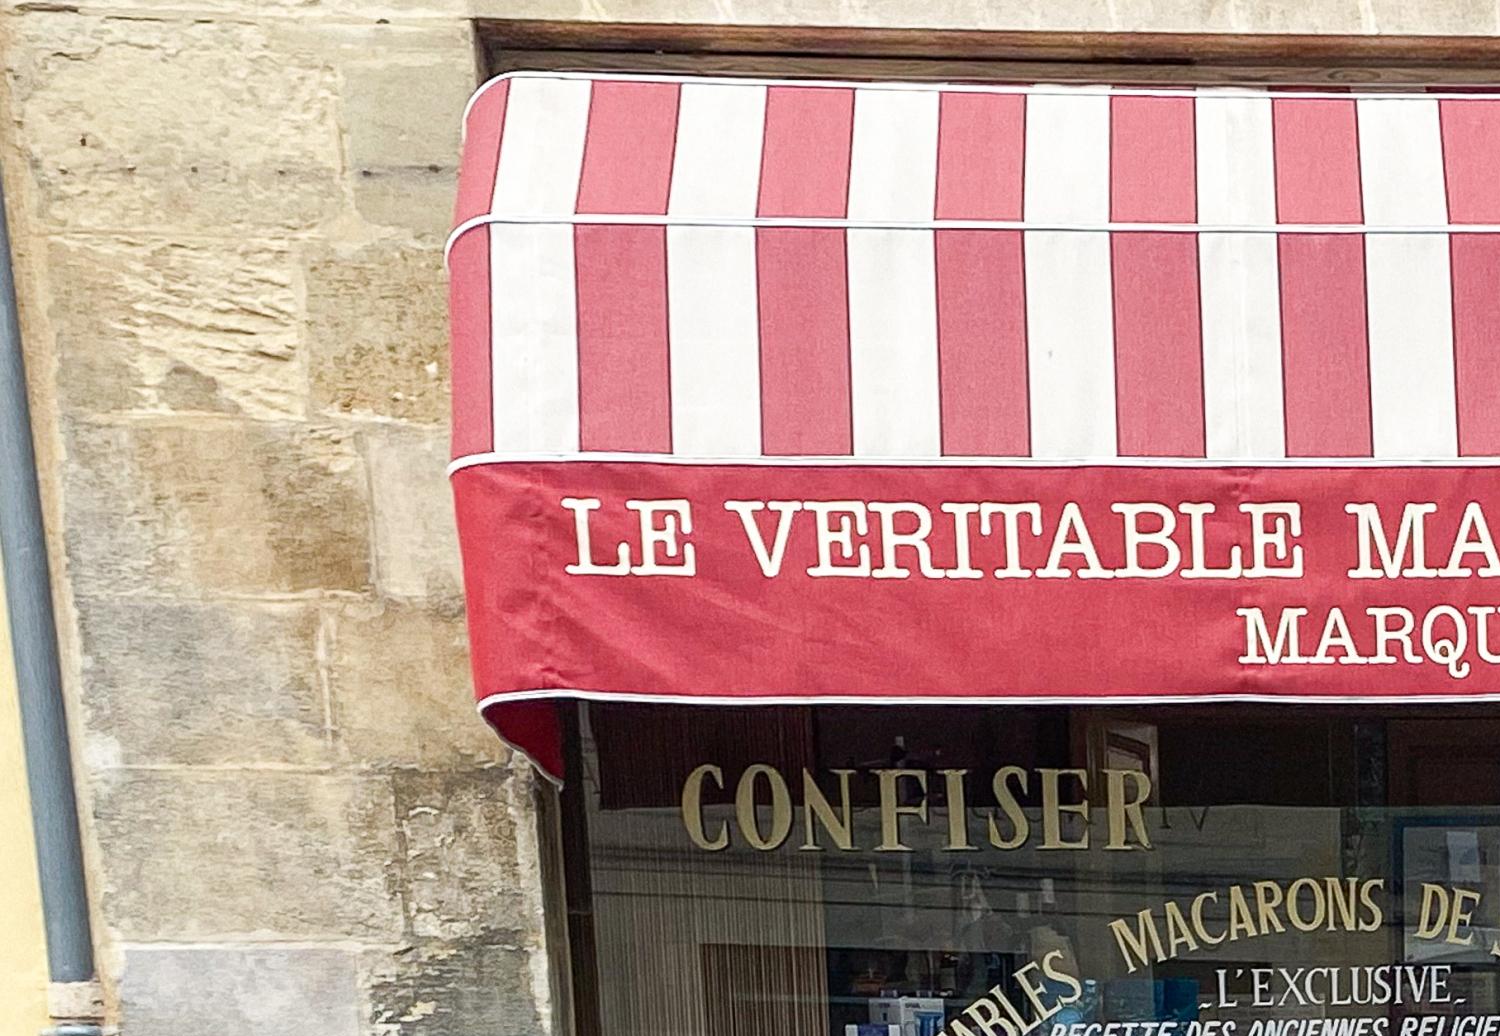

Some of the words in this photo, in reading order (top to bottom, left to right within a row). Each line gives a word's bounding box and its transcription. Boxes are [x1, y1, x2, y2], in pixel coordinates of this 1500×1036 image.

[562, 497, 697, 577] LE
[725, 500, 1303, 580] VERITABLE
[681, 764, 1154, 852] CONFISER
[1107, 877, 1385, 974] MACARONS
[1413, 882, 1481, 946] DE
